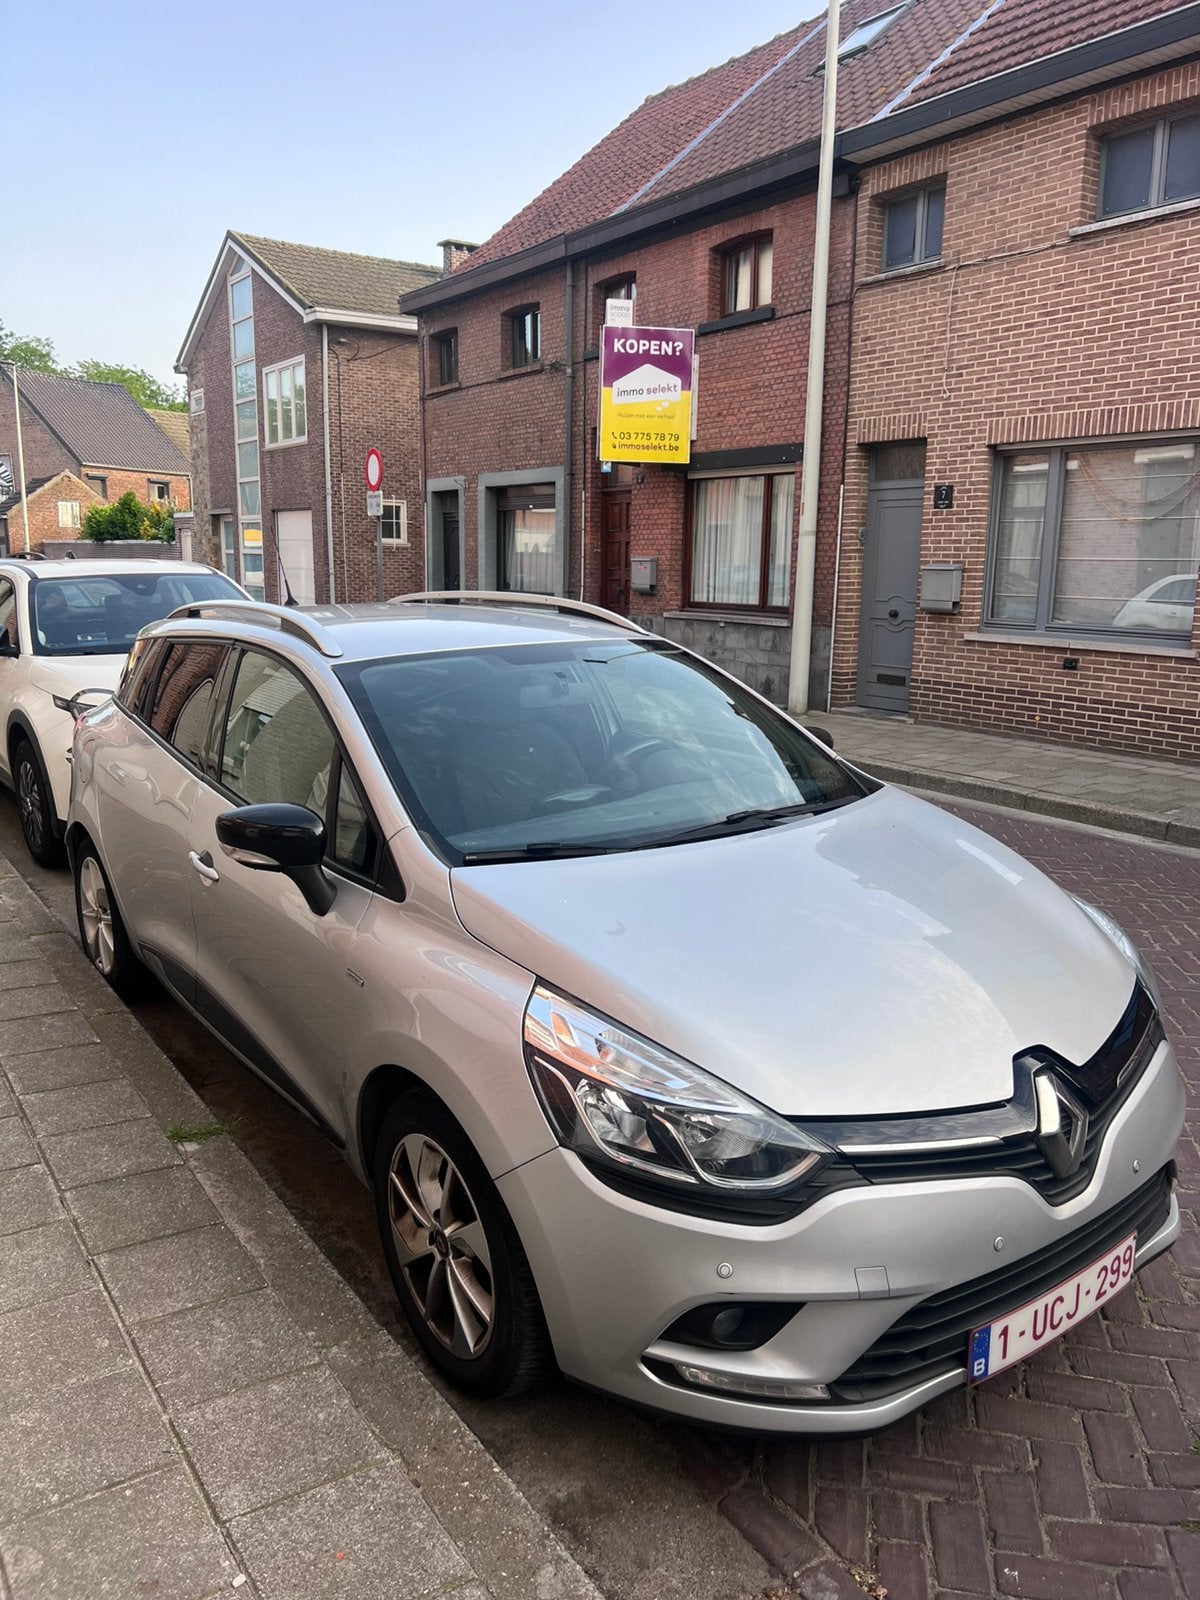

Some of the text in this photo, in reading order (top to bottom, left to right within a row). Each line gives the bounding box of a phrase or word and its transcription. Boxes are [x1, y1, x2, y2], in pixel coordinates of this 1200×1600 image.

[613, 338, 684, 356] KOPEN?
[617, 383, 677, 397] immo selekt
[619, 431, 679, 442] 03 775 78 79
[618, 442, 679, 452] immoselekt.be
[998, 1244, 1133, 1360] 1-UCJ-299
[973, 1357, 985, 1376] B
